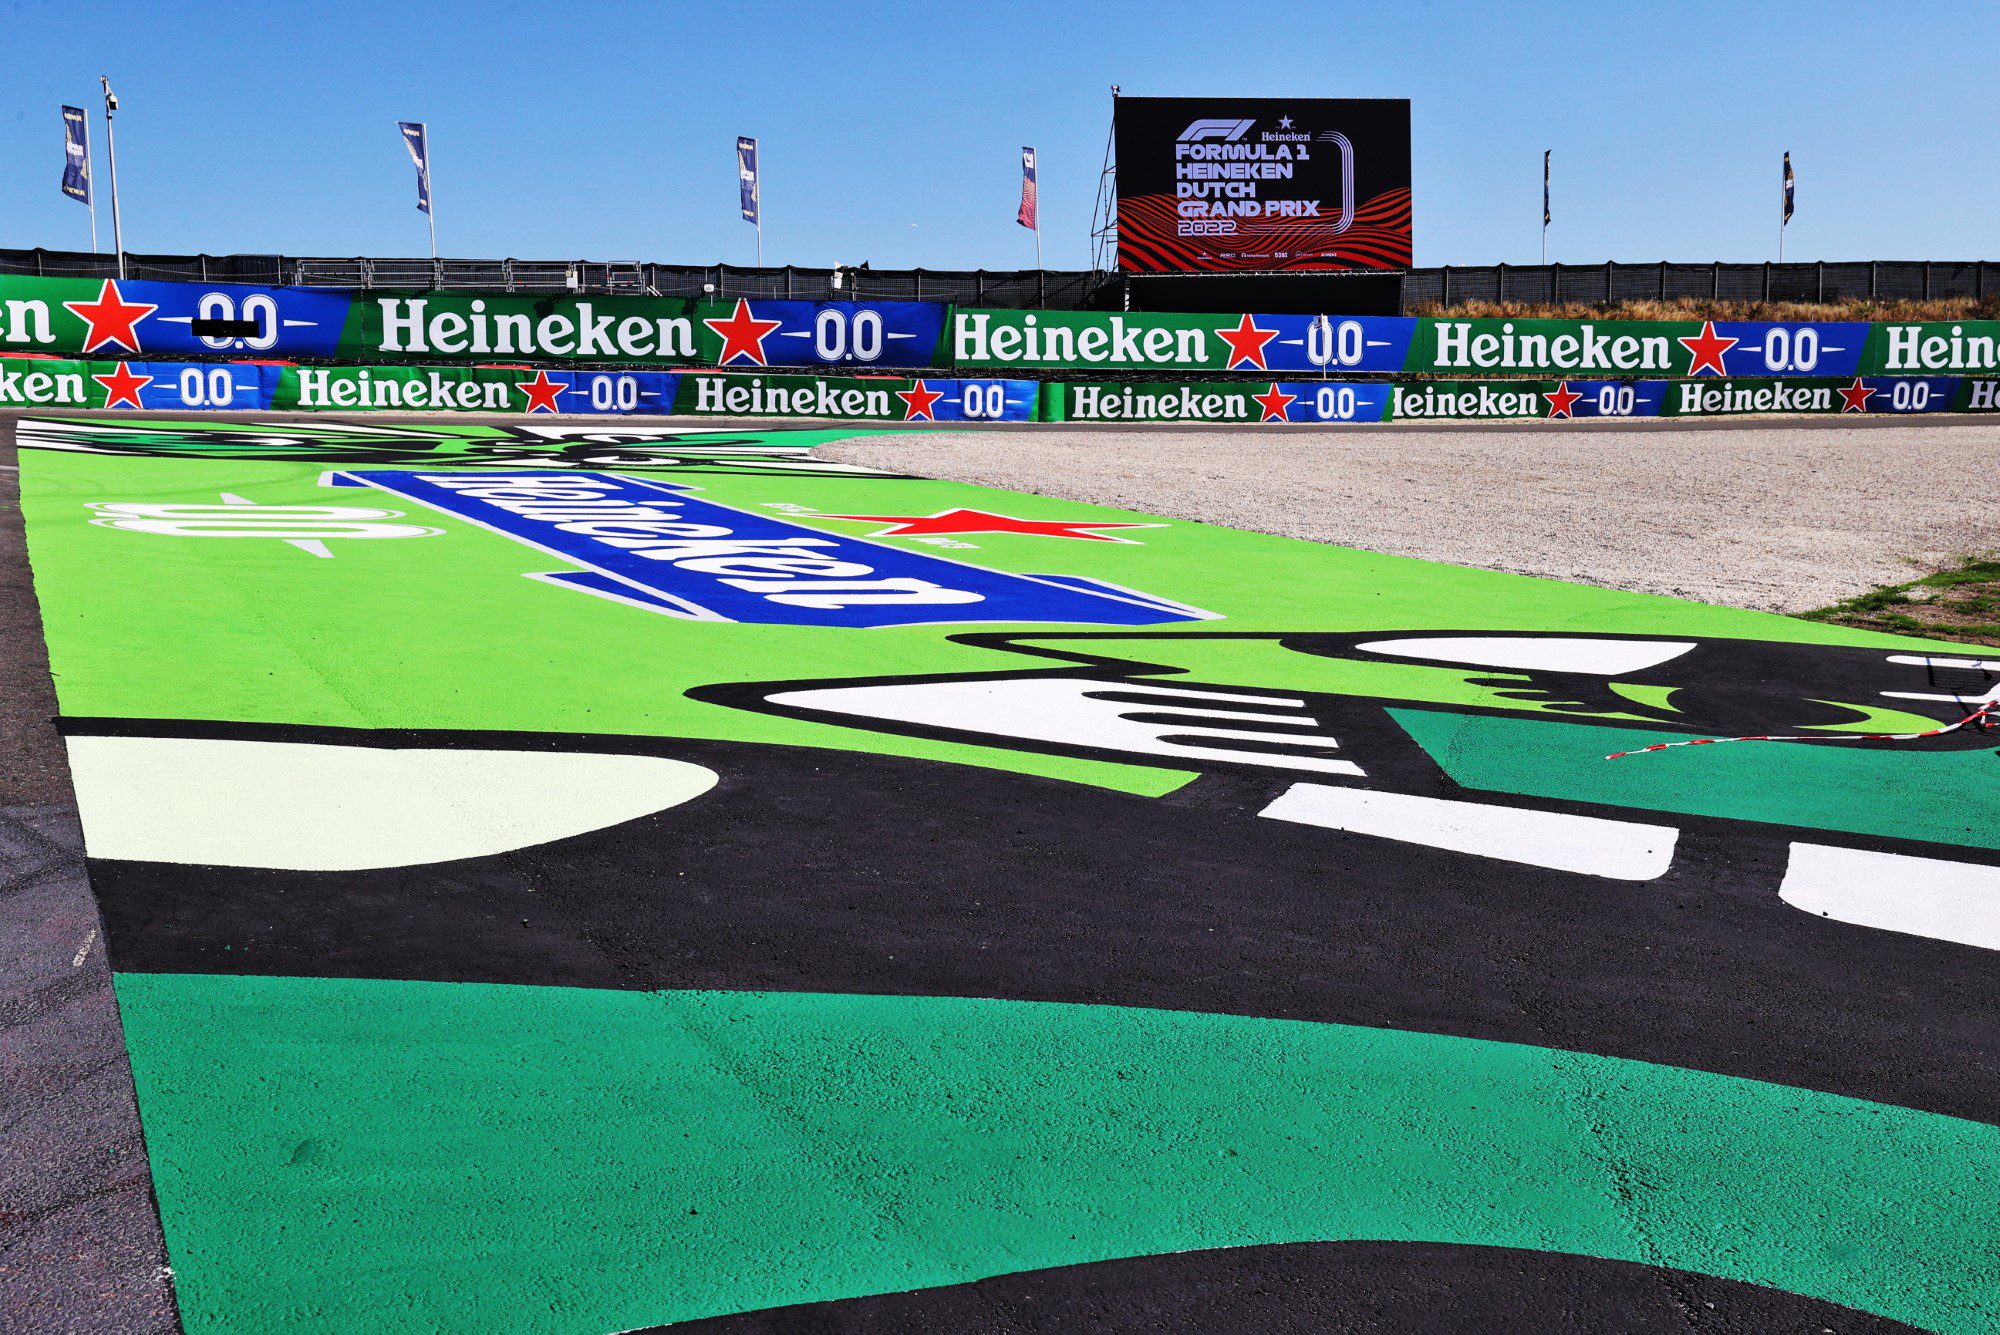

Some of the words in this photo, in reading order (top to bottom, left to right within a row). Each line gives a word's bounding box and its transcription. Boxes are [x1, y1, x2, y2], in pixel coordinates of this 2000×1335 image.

[1175, 143, 1293, 160] FORMULA
[1296, 143, 1310, 160] 1
[1261, 131, 1311, 142] Heineken
[1176, 163, 1293, 180] HEINEKEN
[1176, 182, 1256, 198] DUTCH
[1177, 200, 1261, 217] GRAND
[1265, 200, 1320, 217] PRIX
[1177, 219, 1239, 237] 2022
[198, 291, 278, 350] 0.0
[377, 298, 697, 357] Heineken
[815, 308, 882, 361] 0.0
[954, 313, 1210, 363] Heineken
[1307, 320, 1363, 366] 0.0
[1433, 322, 1672, 370] Heineken
[1765, 327, 1818, 372] 0.0
[1884, 325, 2000, 369] Hein
[180, 367, 233, 406] 0.0
[296, 369, 511, 409] Heineken
[592, 375, 637, 411] 0.0
[695, 377, 892, 416] Heineken
[963, 384, 1004, 418] 0.0
[1072, 386, 1248, 419] Heineken
[1317, 387, 1355, 419] 0.0
[1598, 385, 1634, 417] 0.0
[1679, 382, 1832, 413] Heineken
[1893, 381, 1930, 410] 0.0
[413, 475, 986, 610] Heineken
